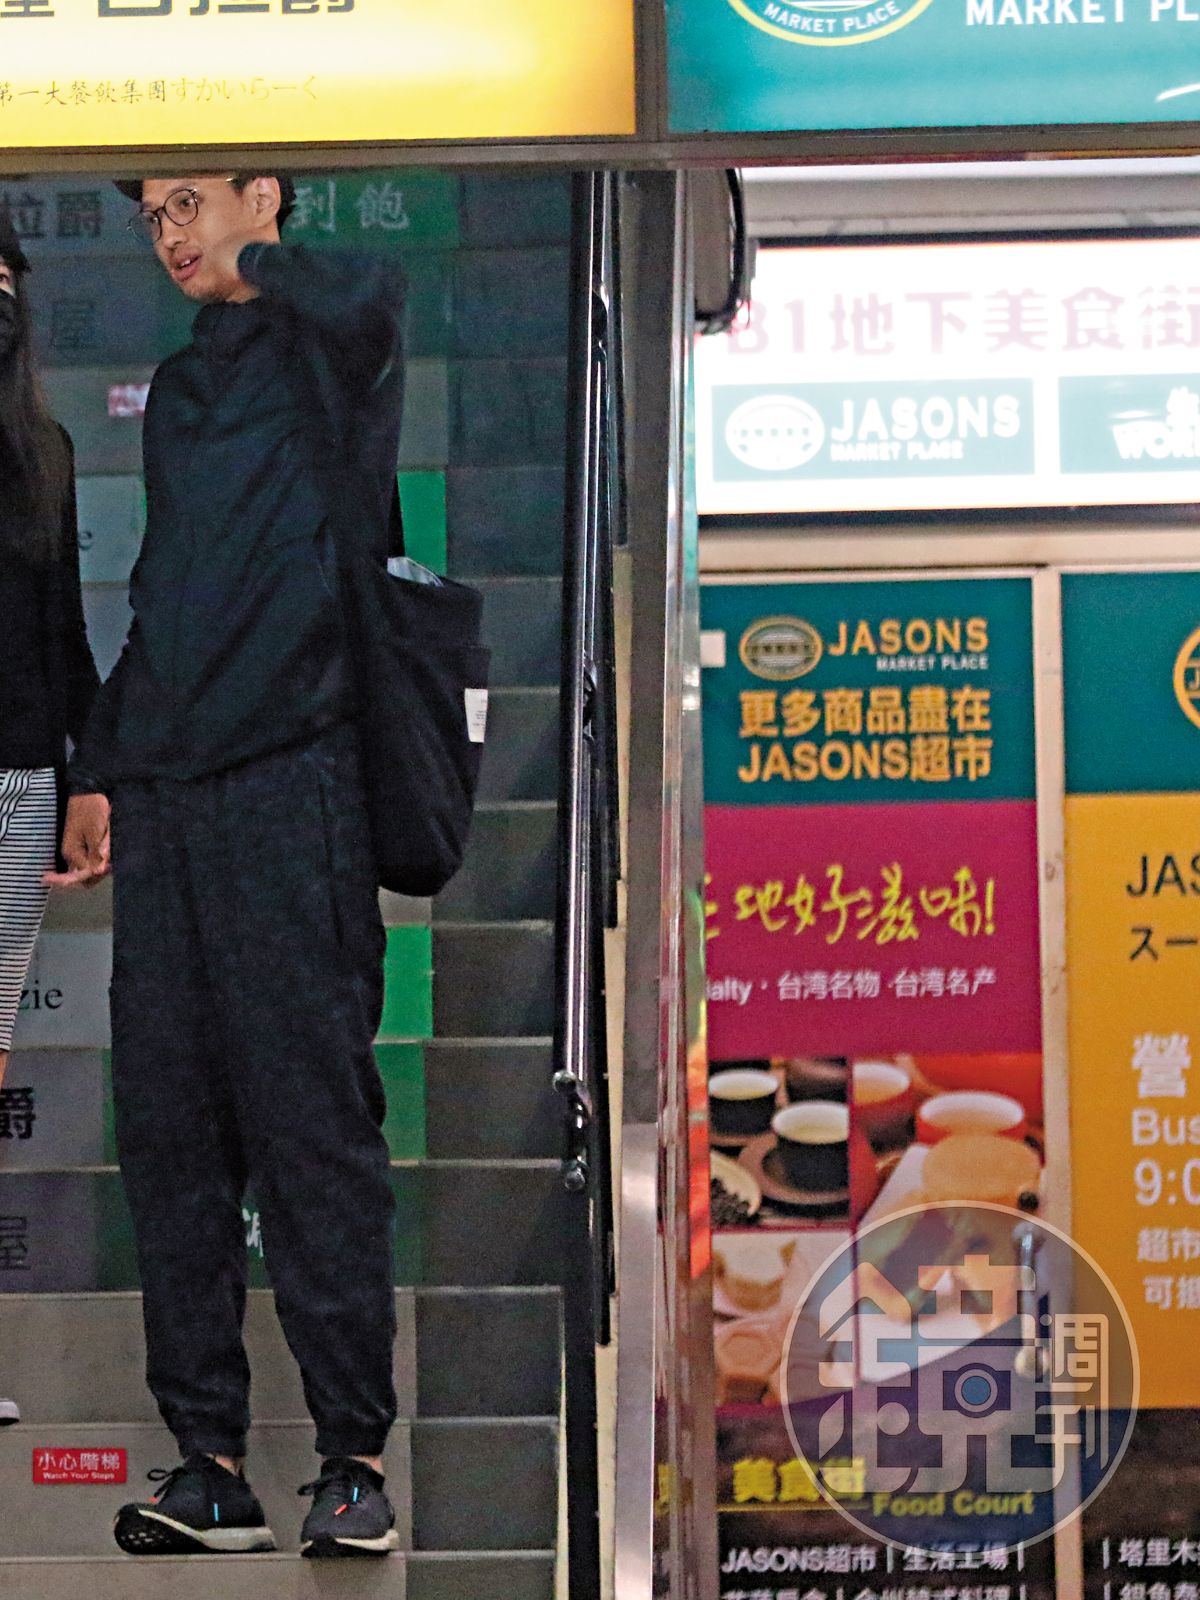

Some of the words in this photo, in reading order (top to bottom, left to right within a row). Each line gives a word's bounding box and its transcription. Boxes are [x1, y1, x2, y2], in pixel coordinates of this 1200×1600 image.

[763, 3, 836, 33] MARKET
[843, 1, 901, 31] PLACE
[966, 0, 1125, 26] MARKET
[831, 394, 1021, 442] JASONS
[828, 617, 989, 656] JASONS
[876, 655, 936, 671] MARKET
[941, 654, 988, 670] PLACE
[739, 685, 992, 737] 更多商品盡在
[738, 736, 993, 782] JASONS超市
[705, 863, 995, 943] 地好滋味!
[778, 970, 881, 1000] 台湾名物
[895, 966, 997, 996] 台湾名产
[1132, 1033, 1192, 1099] 營
[38, 1452, 120, 1471] 小心階梯
[873, 1493, 945, 1517] Food
[953, 1488, 1035, 1515] Court
[720, 1544, 877, 1573] JASONS超市
[1117, 1537, 1200, 1567] 塔里木
